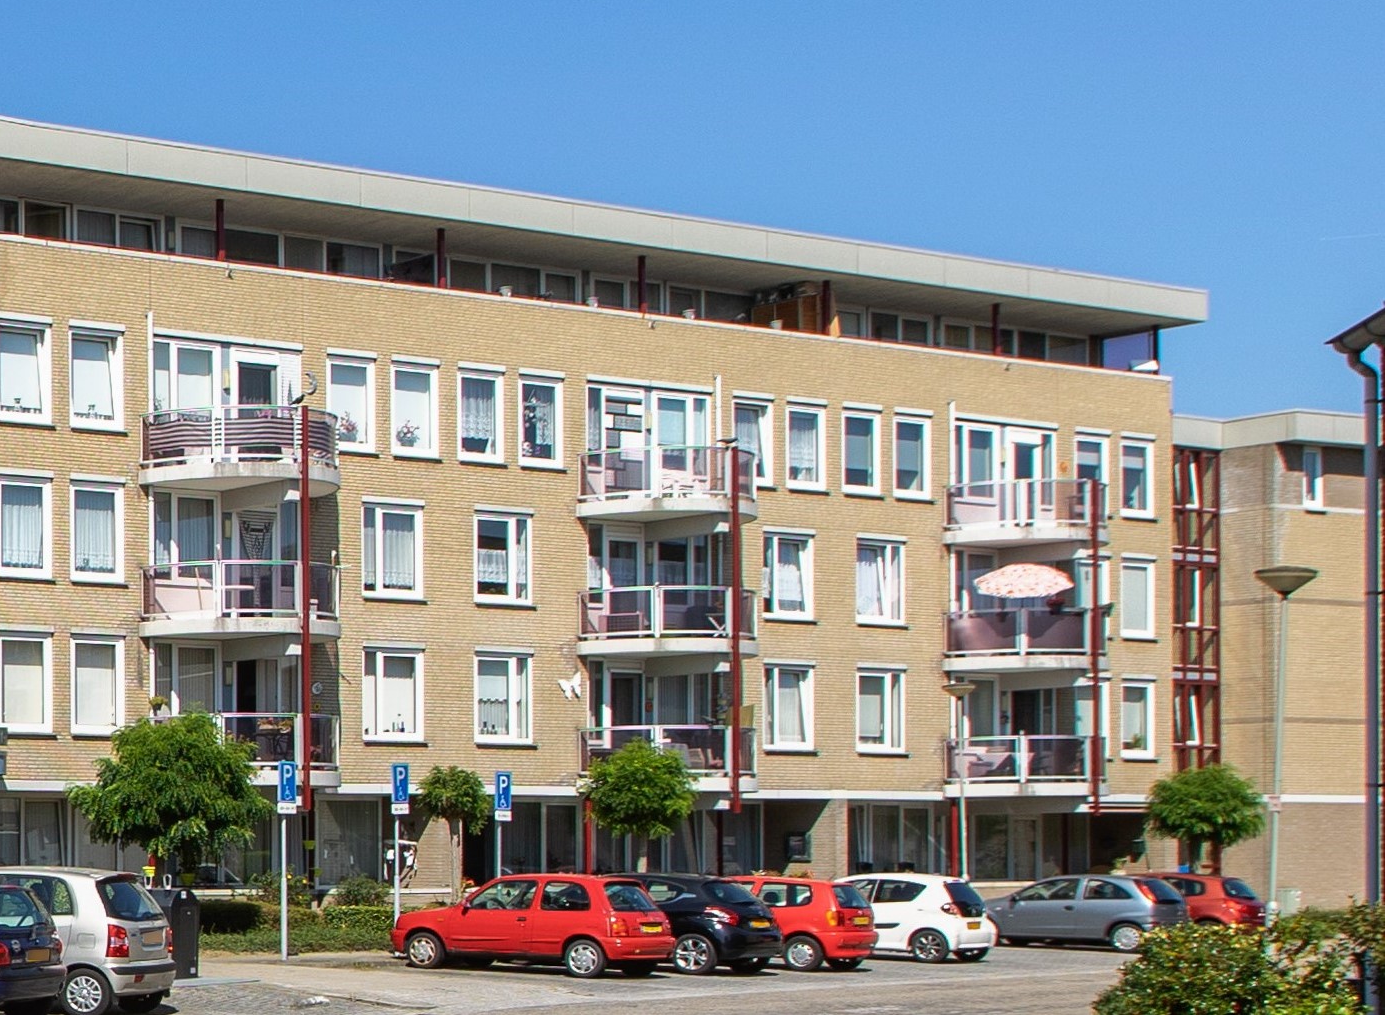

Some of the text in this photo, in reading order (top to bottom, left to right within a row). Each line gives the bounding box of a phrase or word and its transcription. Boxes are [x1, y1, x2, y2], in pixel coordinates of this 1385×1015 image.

[283, 765, 292, 785] P
[397, 767, 405, 786] P
[499, 776, 508, 794] P
